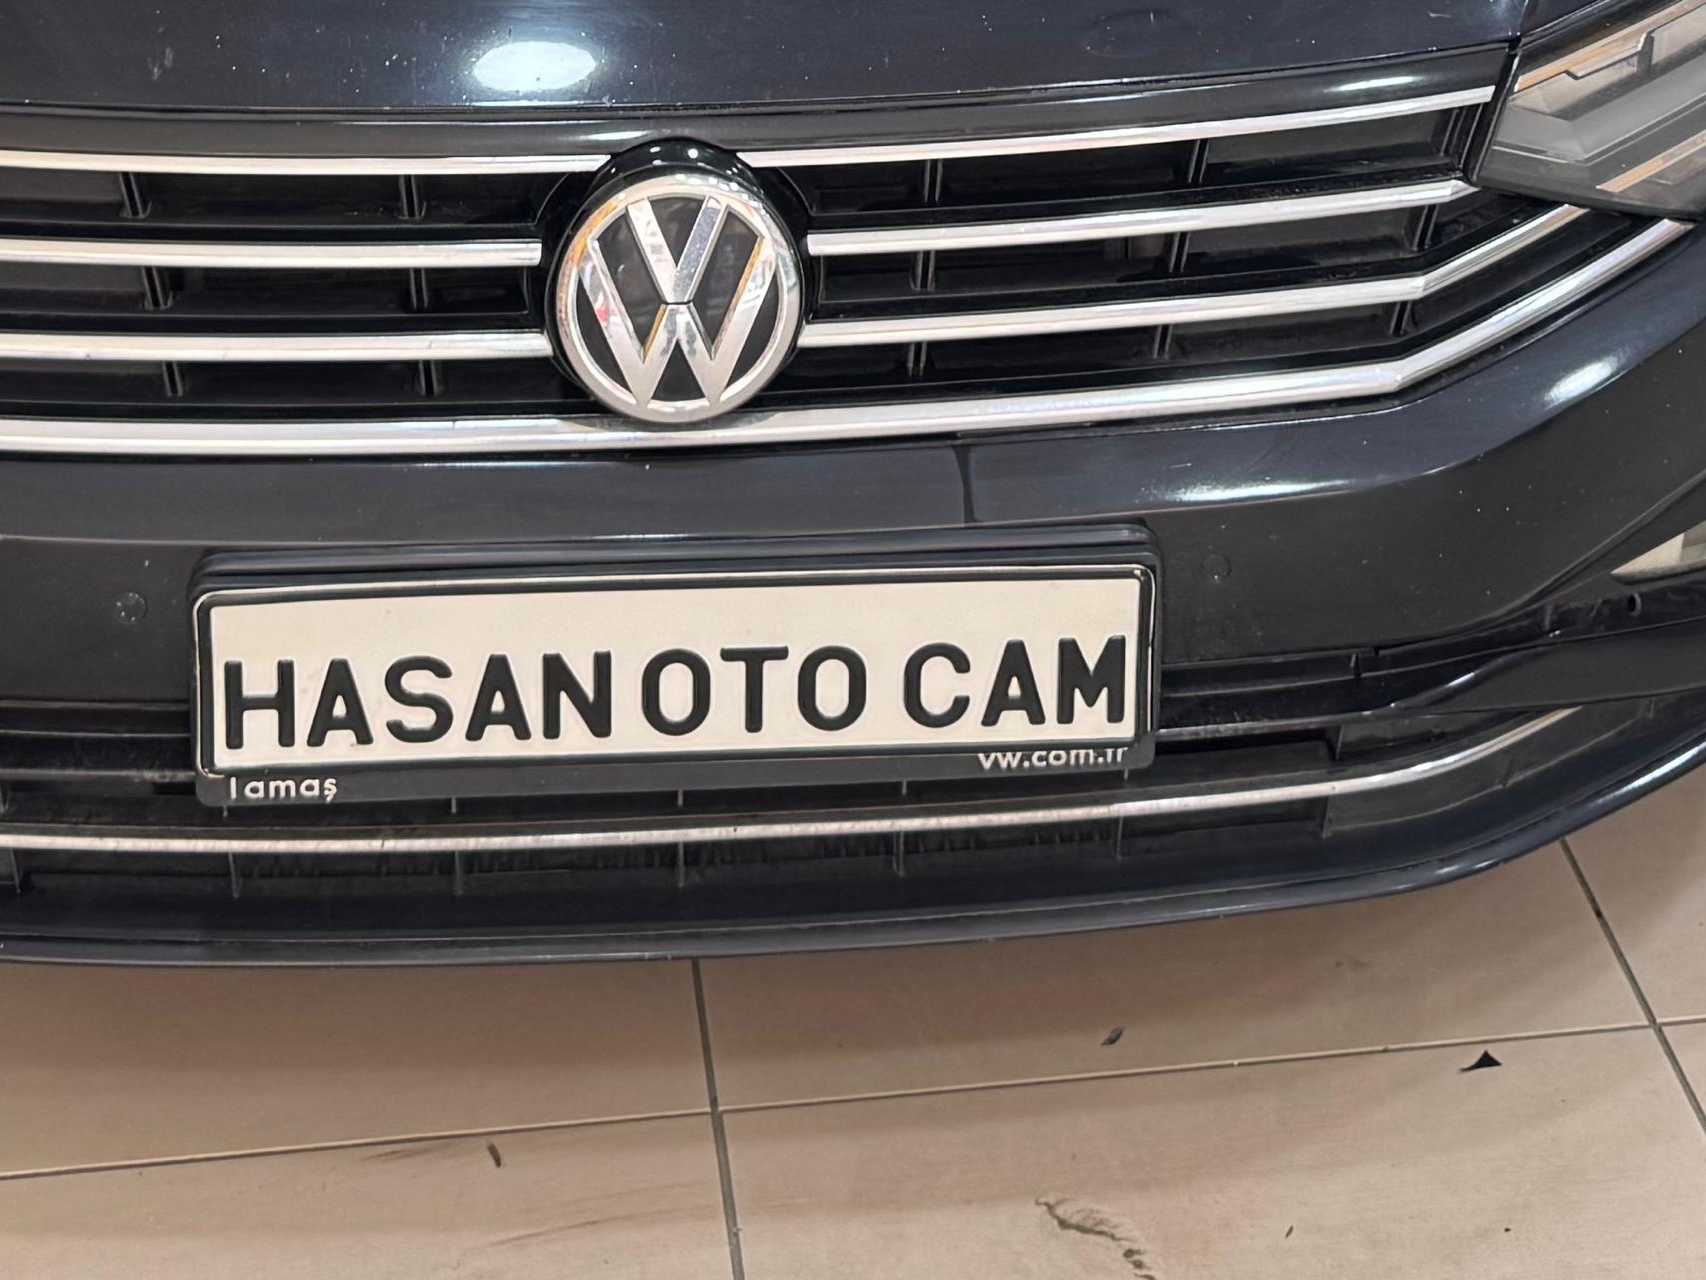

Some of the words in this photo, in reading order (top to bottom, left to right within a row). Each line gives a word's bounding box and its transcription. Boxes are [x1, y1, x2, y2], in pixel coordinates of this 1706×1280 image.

[224, 648, 613, 750] HASAN
[640, 644, 867, 738] OTO
[902, 633, 1127, 730] CAM
